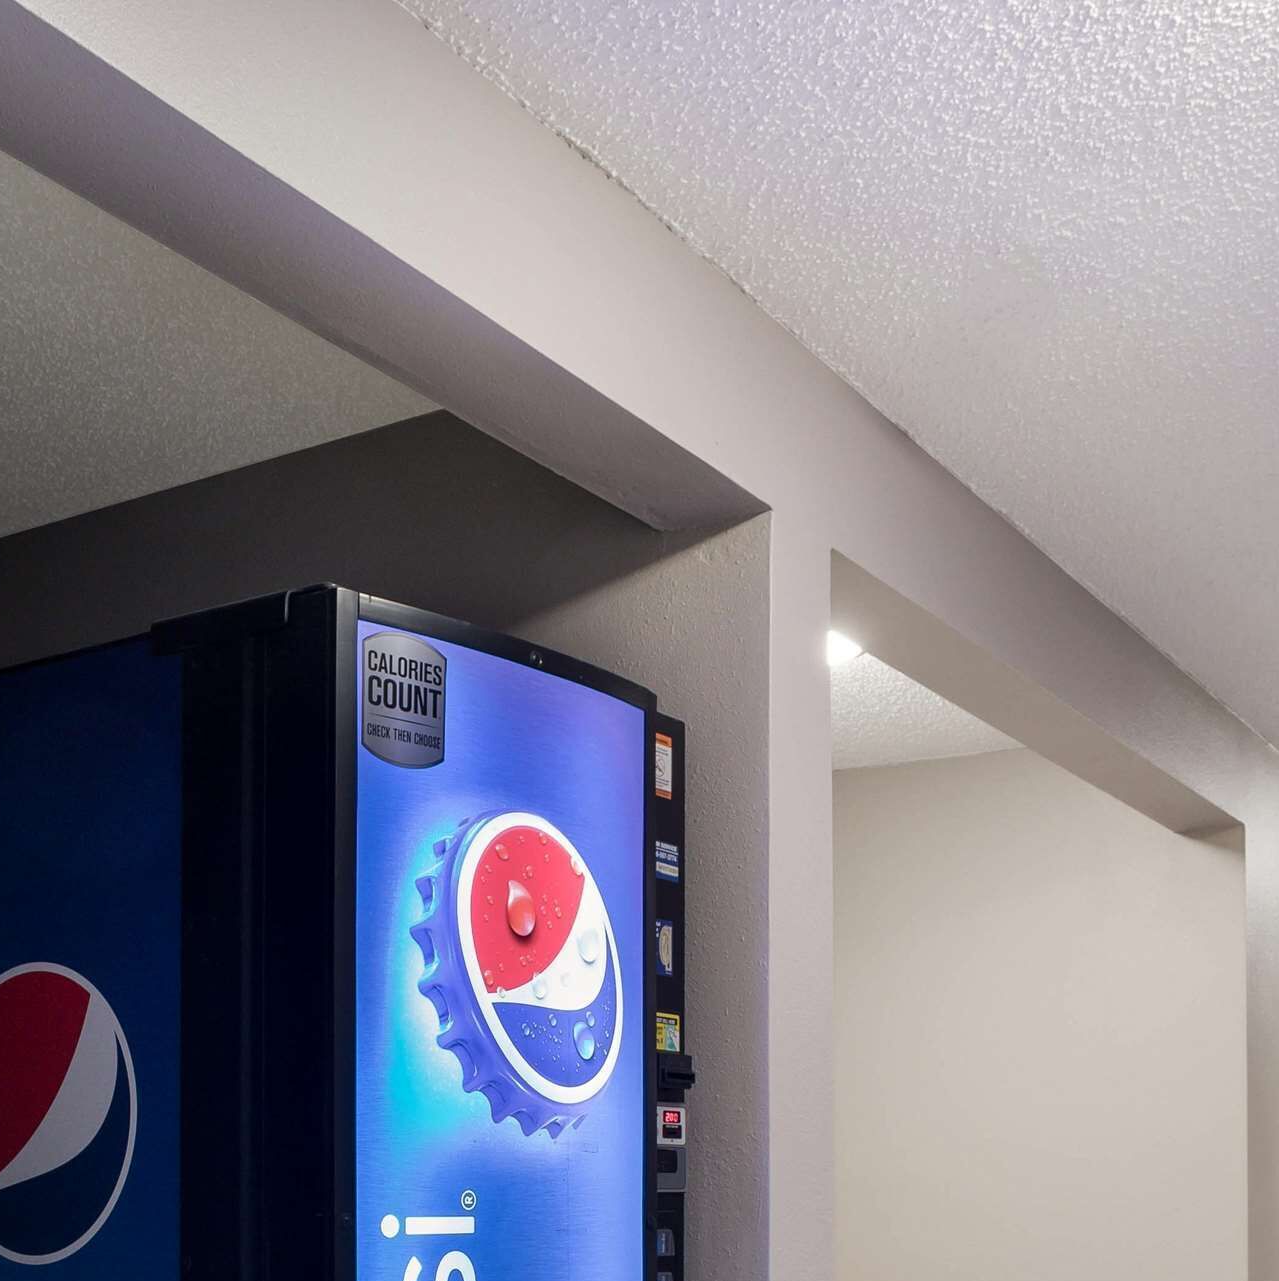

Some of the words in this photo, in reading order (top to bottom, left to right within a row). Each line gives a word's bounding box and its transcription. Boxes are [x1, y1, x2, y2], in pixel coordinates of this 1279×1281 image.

[367, 649, 443, 687] CALORIES
[367, 674, 442, 719] COUNT
[366, 722, 391, 740] CHECK
[393, 727, 412, 744] THEN
[414, 732, 441, 750] CHOOSE
